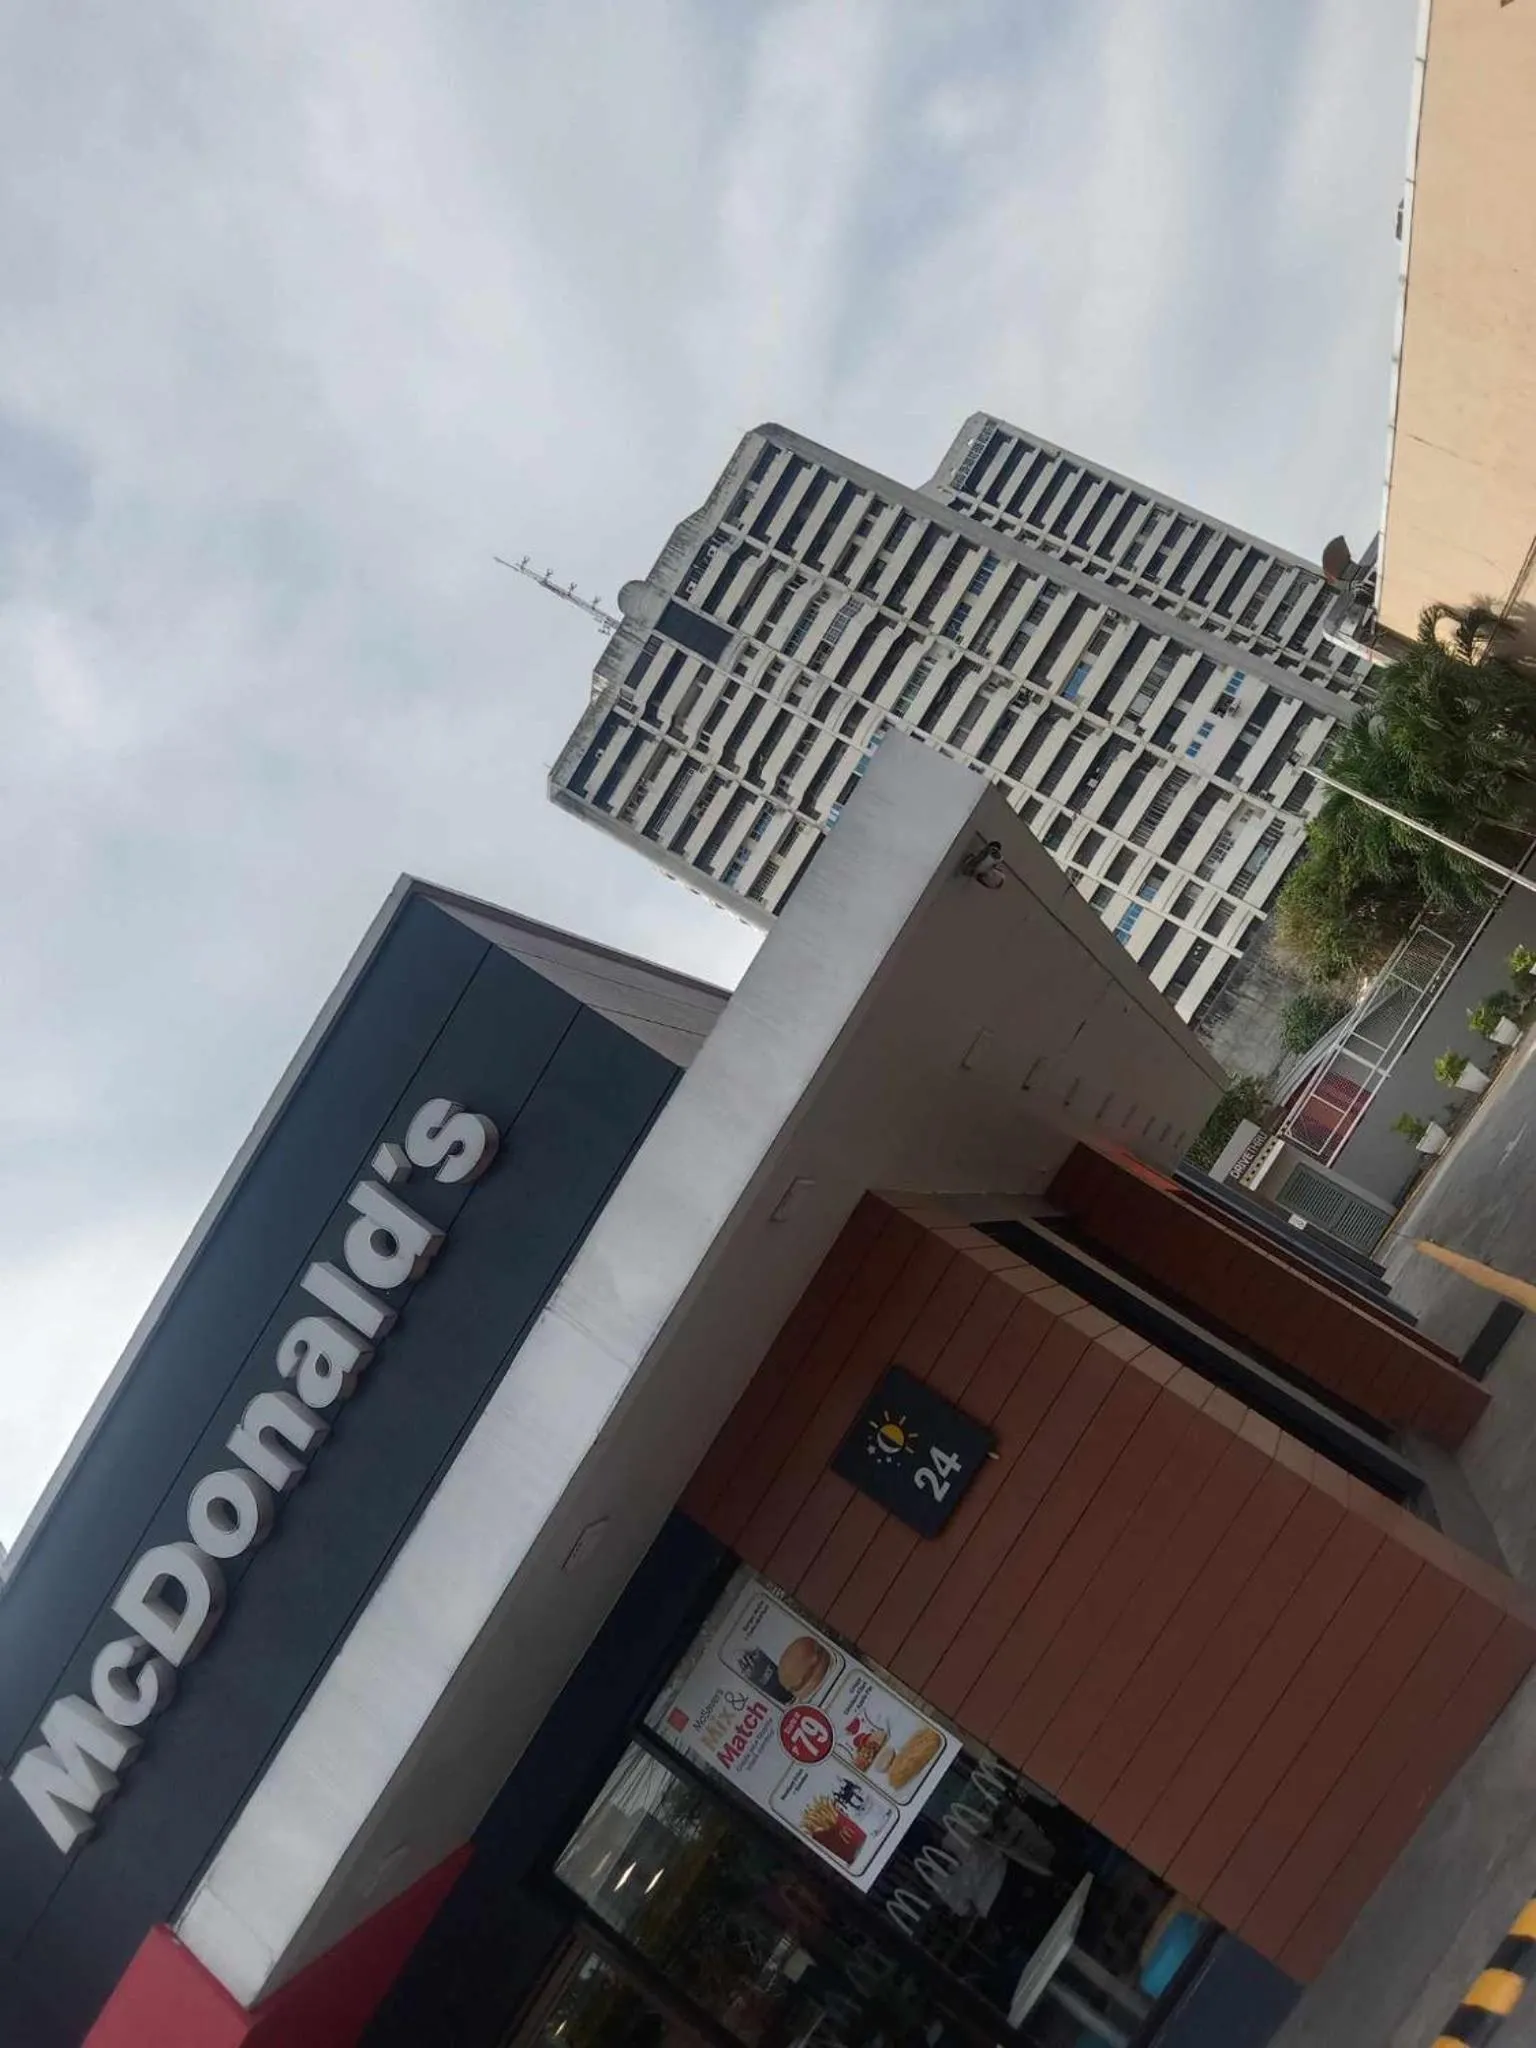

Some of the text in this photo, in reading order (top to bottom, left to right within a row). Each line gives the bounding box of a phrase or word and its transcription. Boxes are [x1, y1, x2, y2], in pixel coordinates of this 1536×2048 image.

[11, 1097, 498, 1855] McDonald's
[914, 1446, 962, 1502] 24
[716, 1701, 768, 1770] Match
